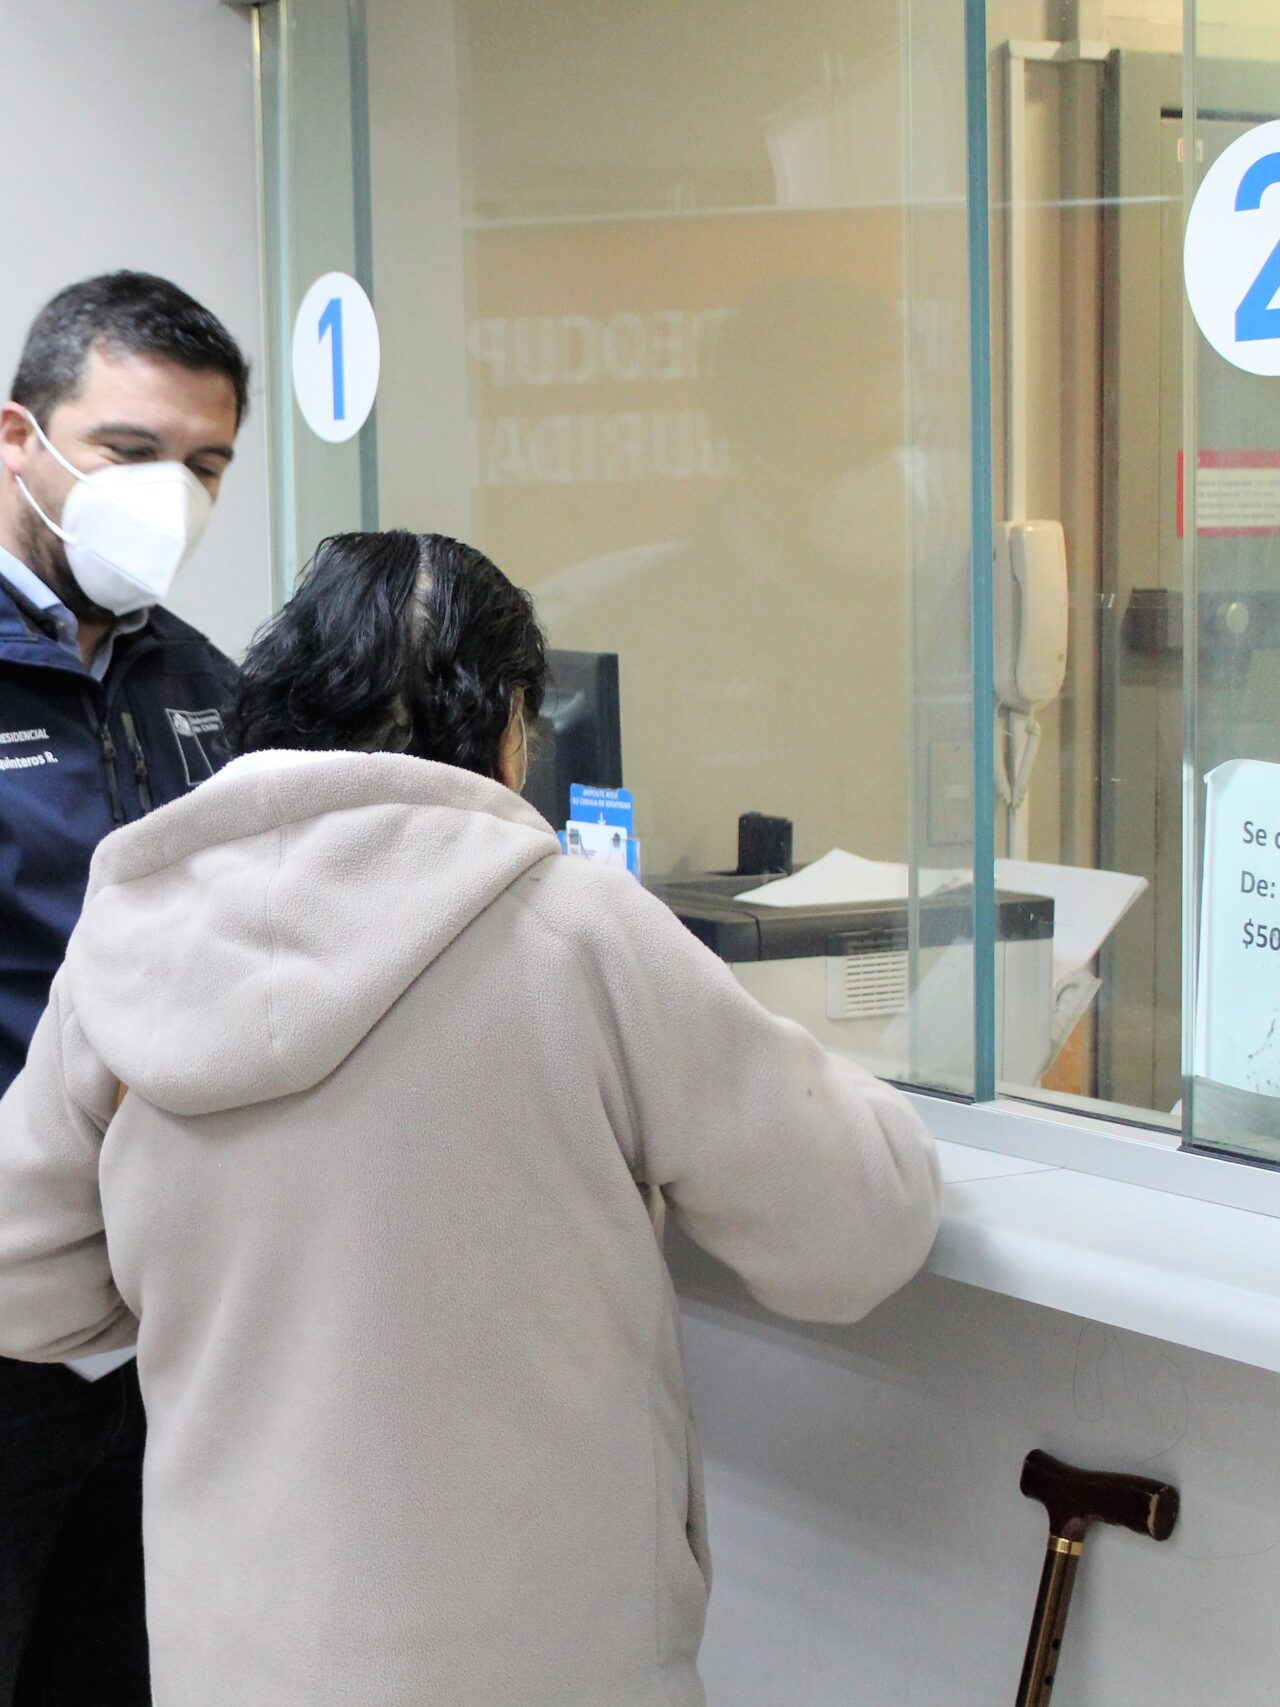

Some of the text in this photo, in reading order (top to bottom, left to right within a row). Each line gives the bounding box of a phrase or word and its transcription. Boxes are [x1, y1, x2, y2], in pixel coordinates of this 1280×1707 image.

[318, 297, 346, 421] 1
[44, 751, 58, 763] R.
[1242, 820, 1267, 847] Se
[1240, 871, 1276, 898] De:
